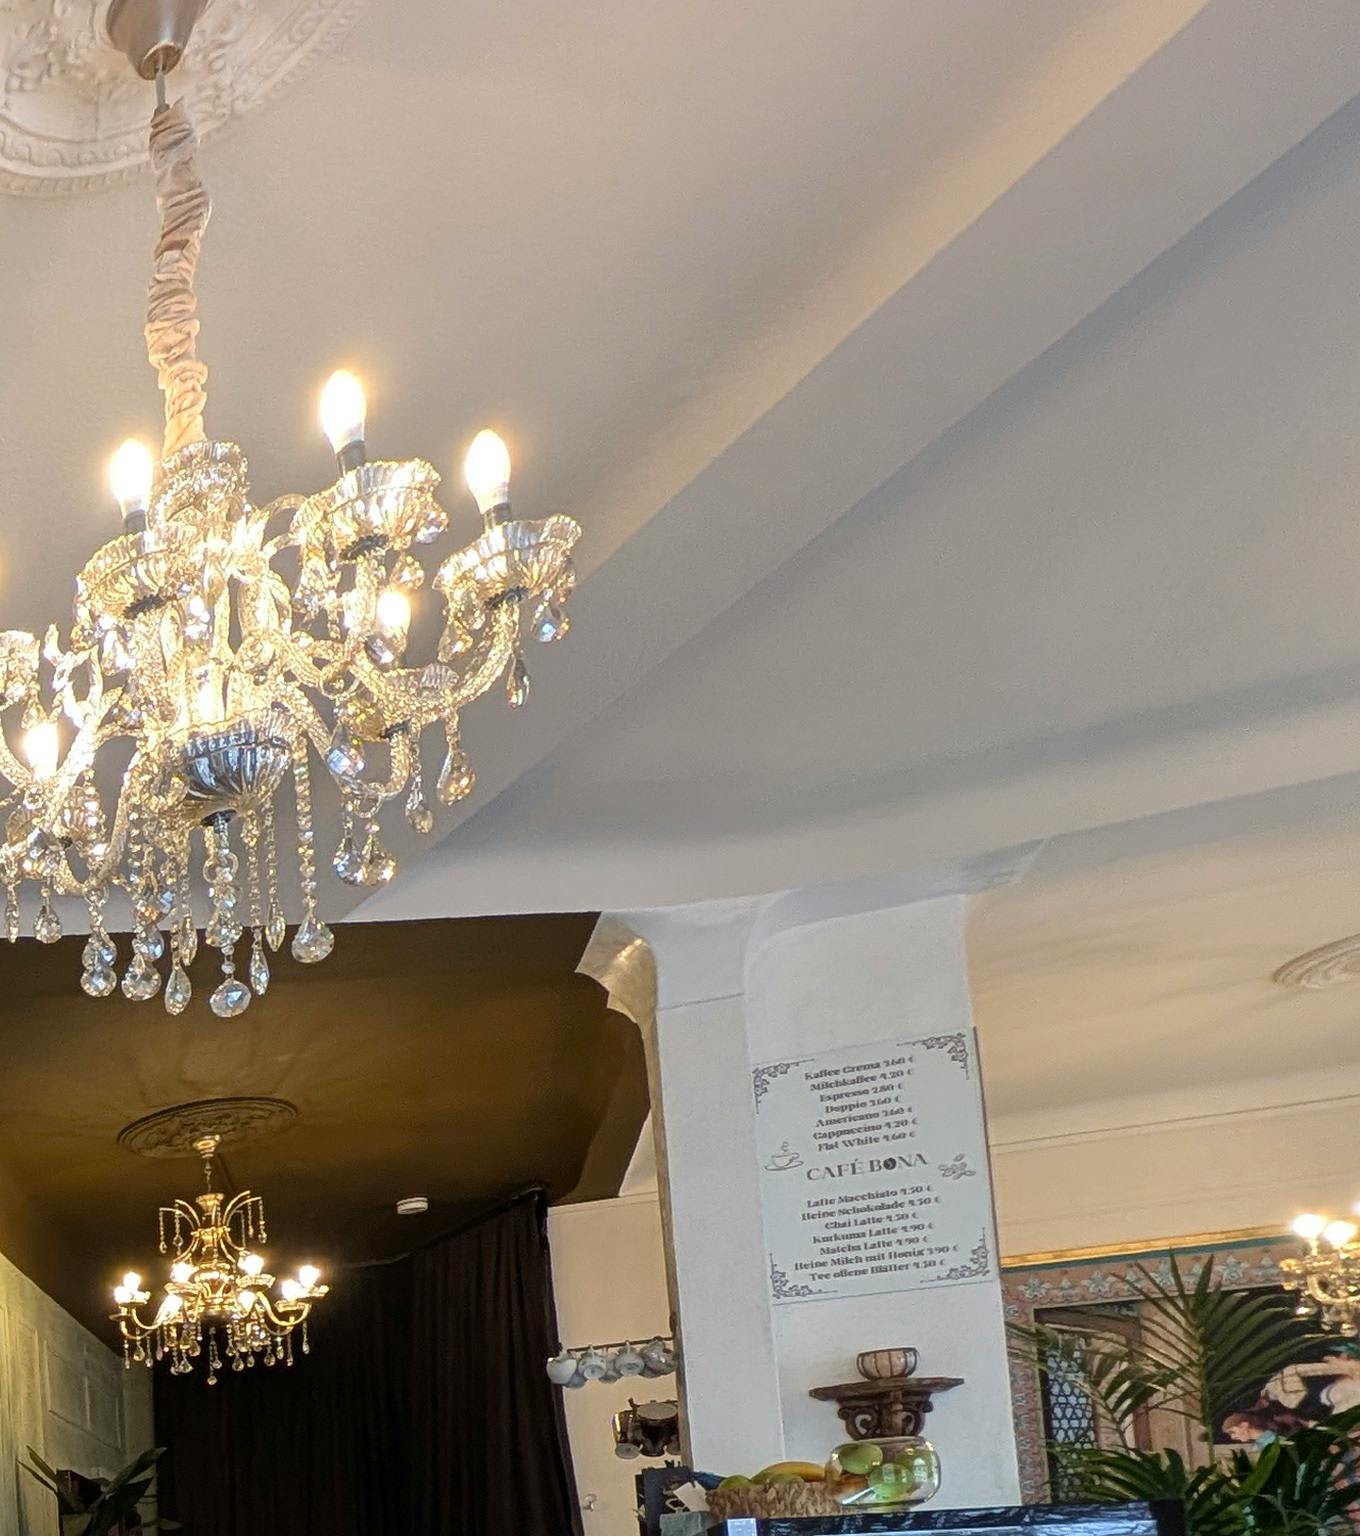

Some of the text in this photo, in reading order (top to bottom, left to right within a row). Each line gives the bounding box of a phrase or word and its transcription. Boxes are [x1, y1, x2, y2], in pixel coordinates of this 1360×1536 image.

[804, 1069, 841, 1081] Kaffee
[842, 1062, 881, 1074] Crema
[810, 1075, 878, 1092] Milchkaffee
[879, 1070, 904, 1080] 4.20
[820, 1089, 870, 1102] Espresso
[825, 1101, 868, 1114] Doppio
[816, 1112, 880, 1128] Americano
[812, 1124, 882, 1140] Cappuccino
[884, 1119, 909, 1130] 4.20
[818, 1141, 839, 1152] Flat
[841, 1136, 880, 1148] White
[806, 1153, 928, 1181] CAFÉ BONA
[807, 1198, 836, 1208] Latte
[838, 1190, 898, 1204] Macchiato
[838, 1200, 906, 1216] Schokolade
[824, 1219, 852, 1230] Chai
[854, 1216, 884, 1227] Latte
[812, 1232, 867, 1244] Kurkuma
[868, 1227, 898, 1238] Latte
[820, 1244, 862, 1256] Matcha
[864, 1240, 893, 1250] Latte
[830, 1255, 863, 1267] Milch
[865, 1253, 886, 1263] mit
[888, 1248, 925, 1260] Honig
[809, 1272, 831, 1282] Tee
[832, 1268, 869, 1278] offene
[870, 1263, 910, 1274] Blätter
